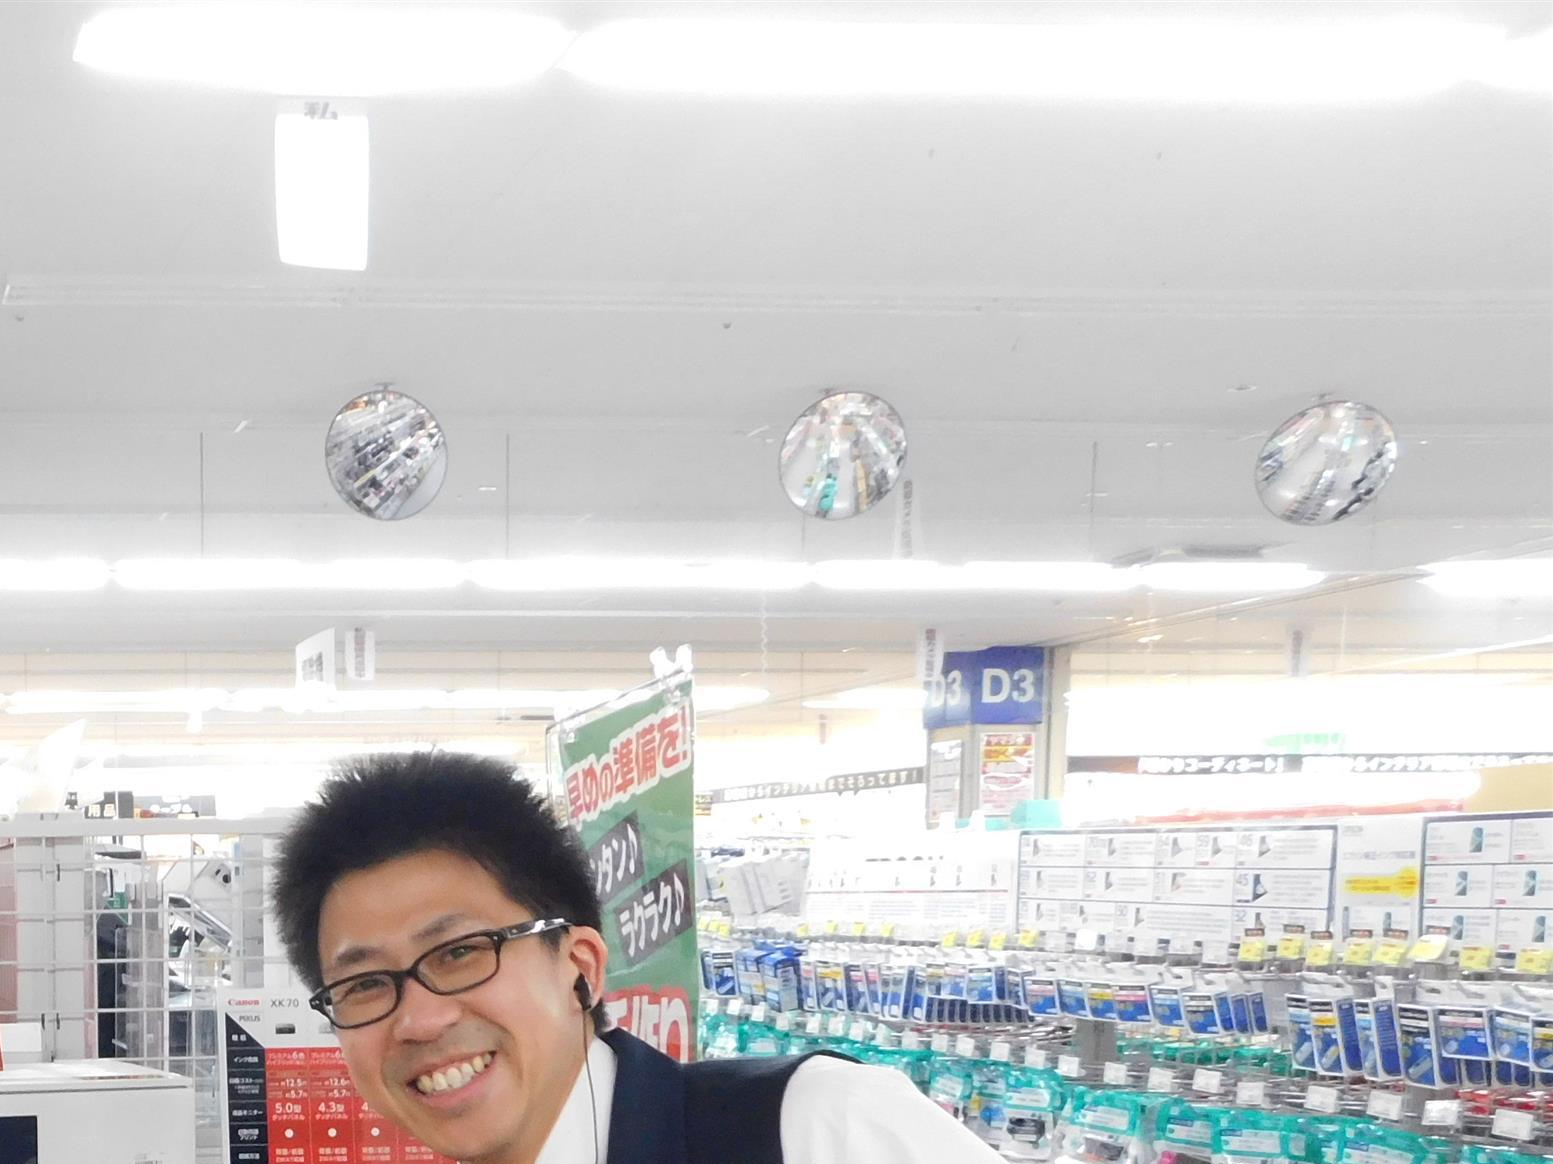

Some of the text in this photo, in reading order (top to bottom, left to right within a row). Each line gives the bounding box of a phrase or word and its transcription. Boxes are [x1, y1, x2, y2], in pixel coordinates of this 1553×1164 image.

[981, 667, 1036, 704] D3
[619, 888, 674, 959] ラクラク
[227, 999, 260, 1007] Canon
